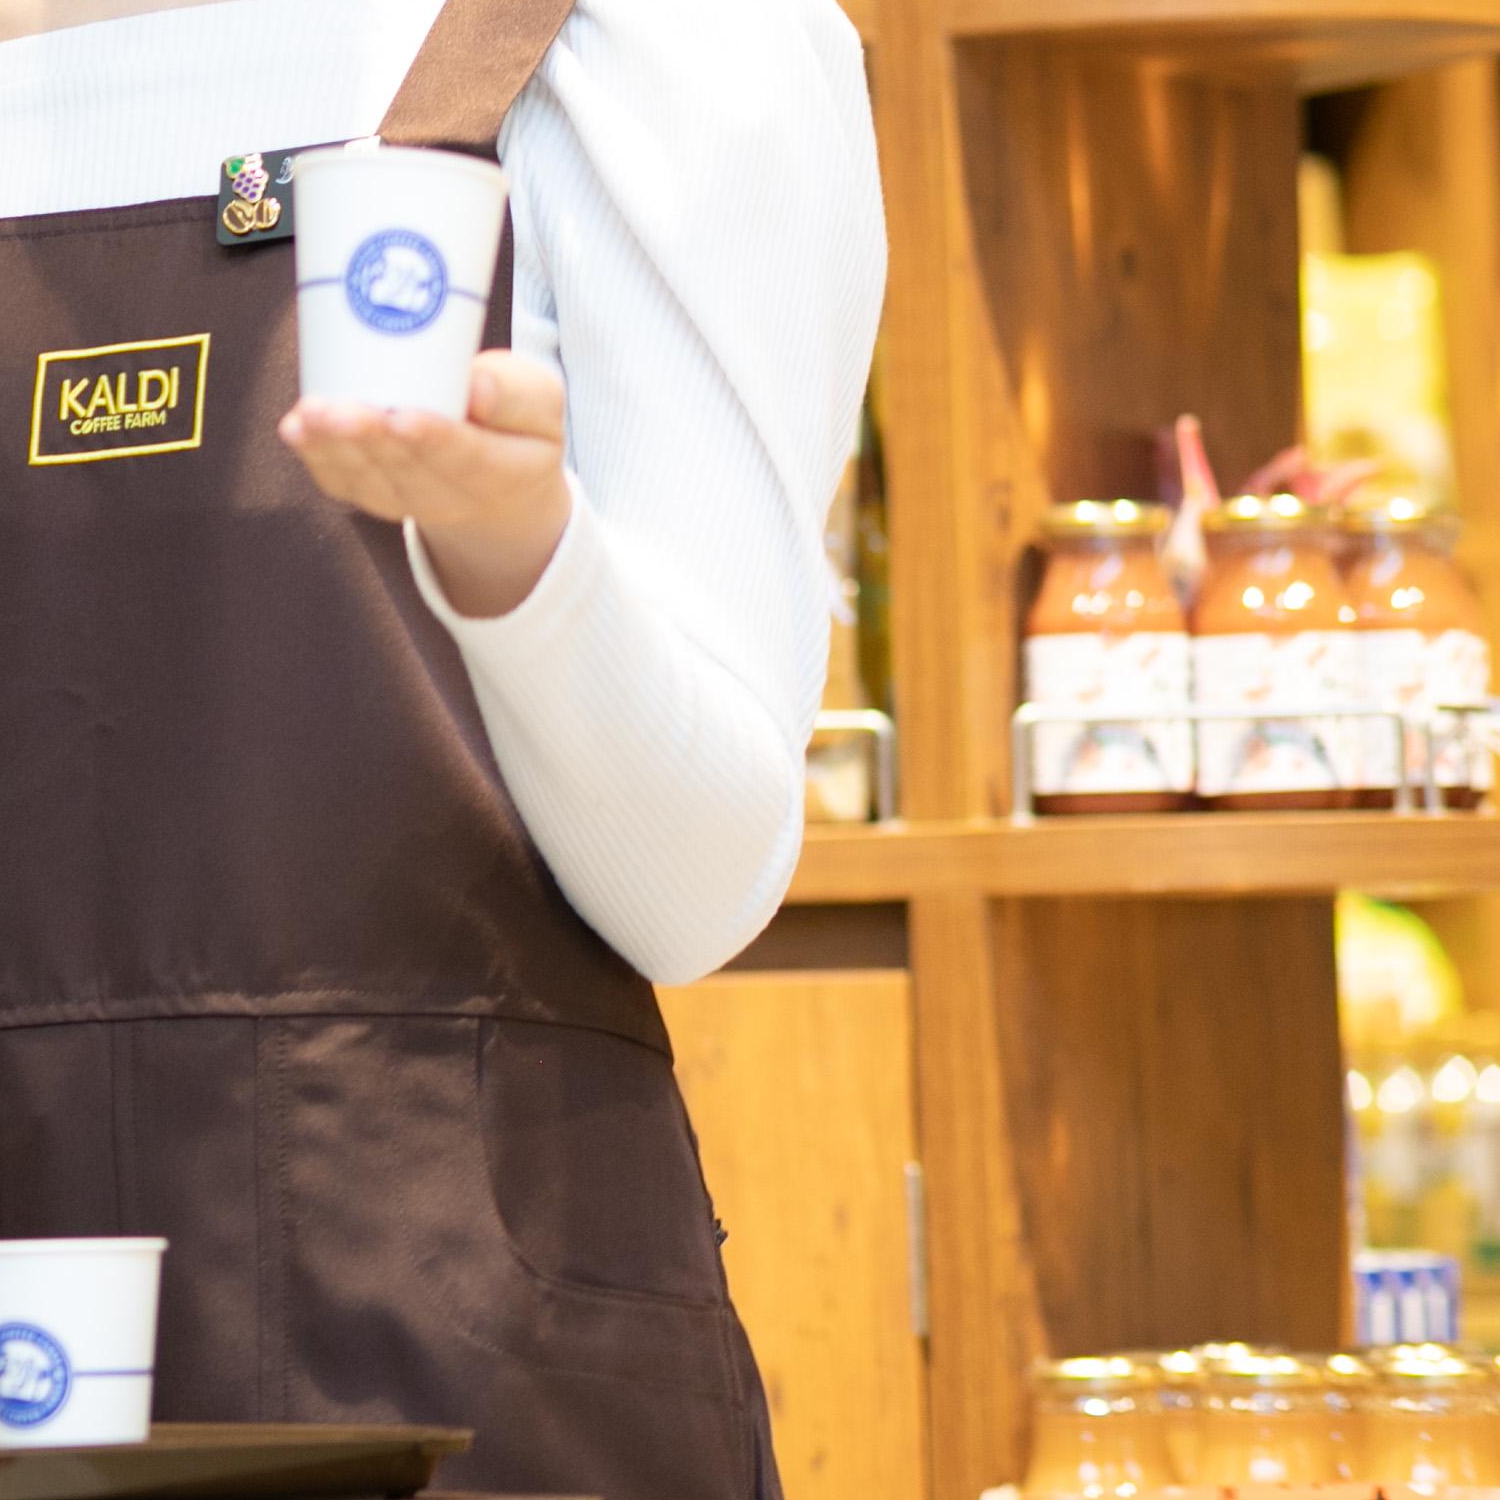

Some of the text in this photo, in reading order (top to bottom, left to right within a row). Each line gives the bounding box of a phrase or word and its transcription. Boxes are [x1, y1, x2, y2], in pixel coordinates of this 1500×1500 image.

[59, 365, 180, 421] KALDI
[69, 409, 168, 436] COFFEE FARM
